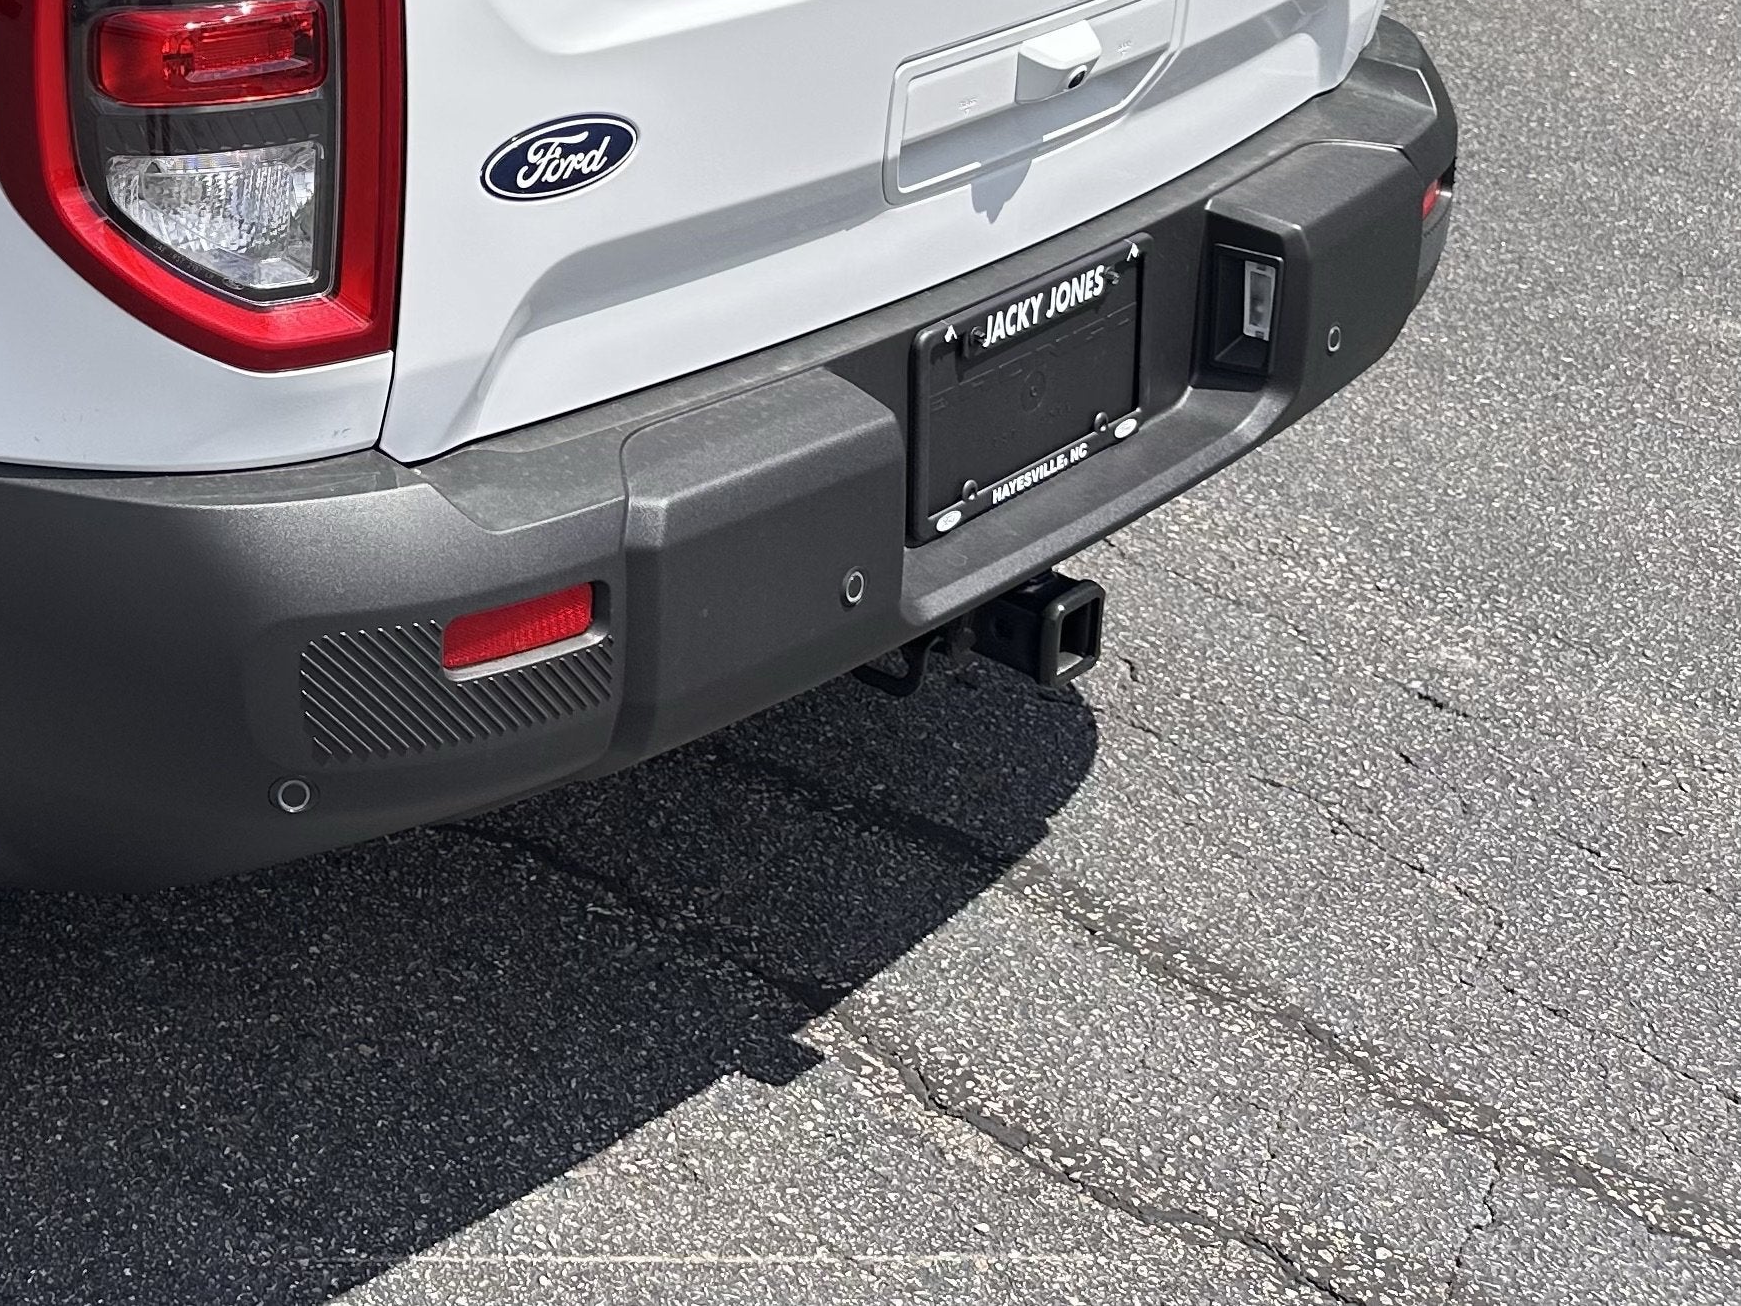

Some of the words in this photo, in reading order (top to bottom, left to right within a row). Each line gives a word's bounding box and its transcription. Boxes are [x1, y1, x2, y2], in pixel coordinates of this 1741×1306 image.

[516, 130, 612, 189] Ford
[982, 292, 1045, 348] JACKY
[1045, 264, 1105, 319] JONES
[991, 453, 1069, 505] HAYESVILLE,
[1069, 442, 1089, 464] NC
